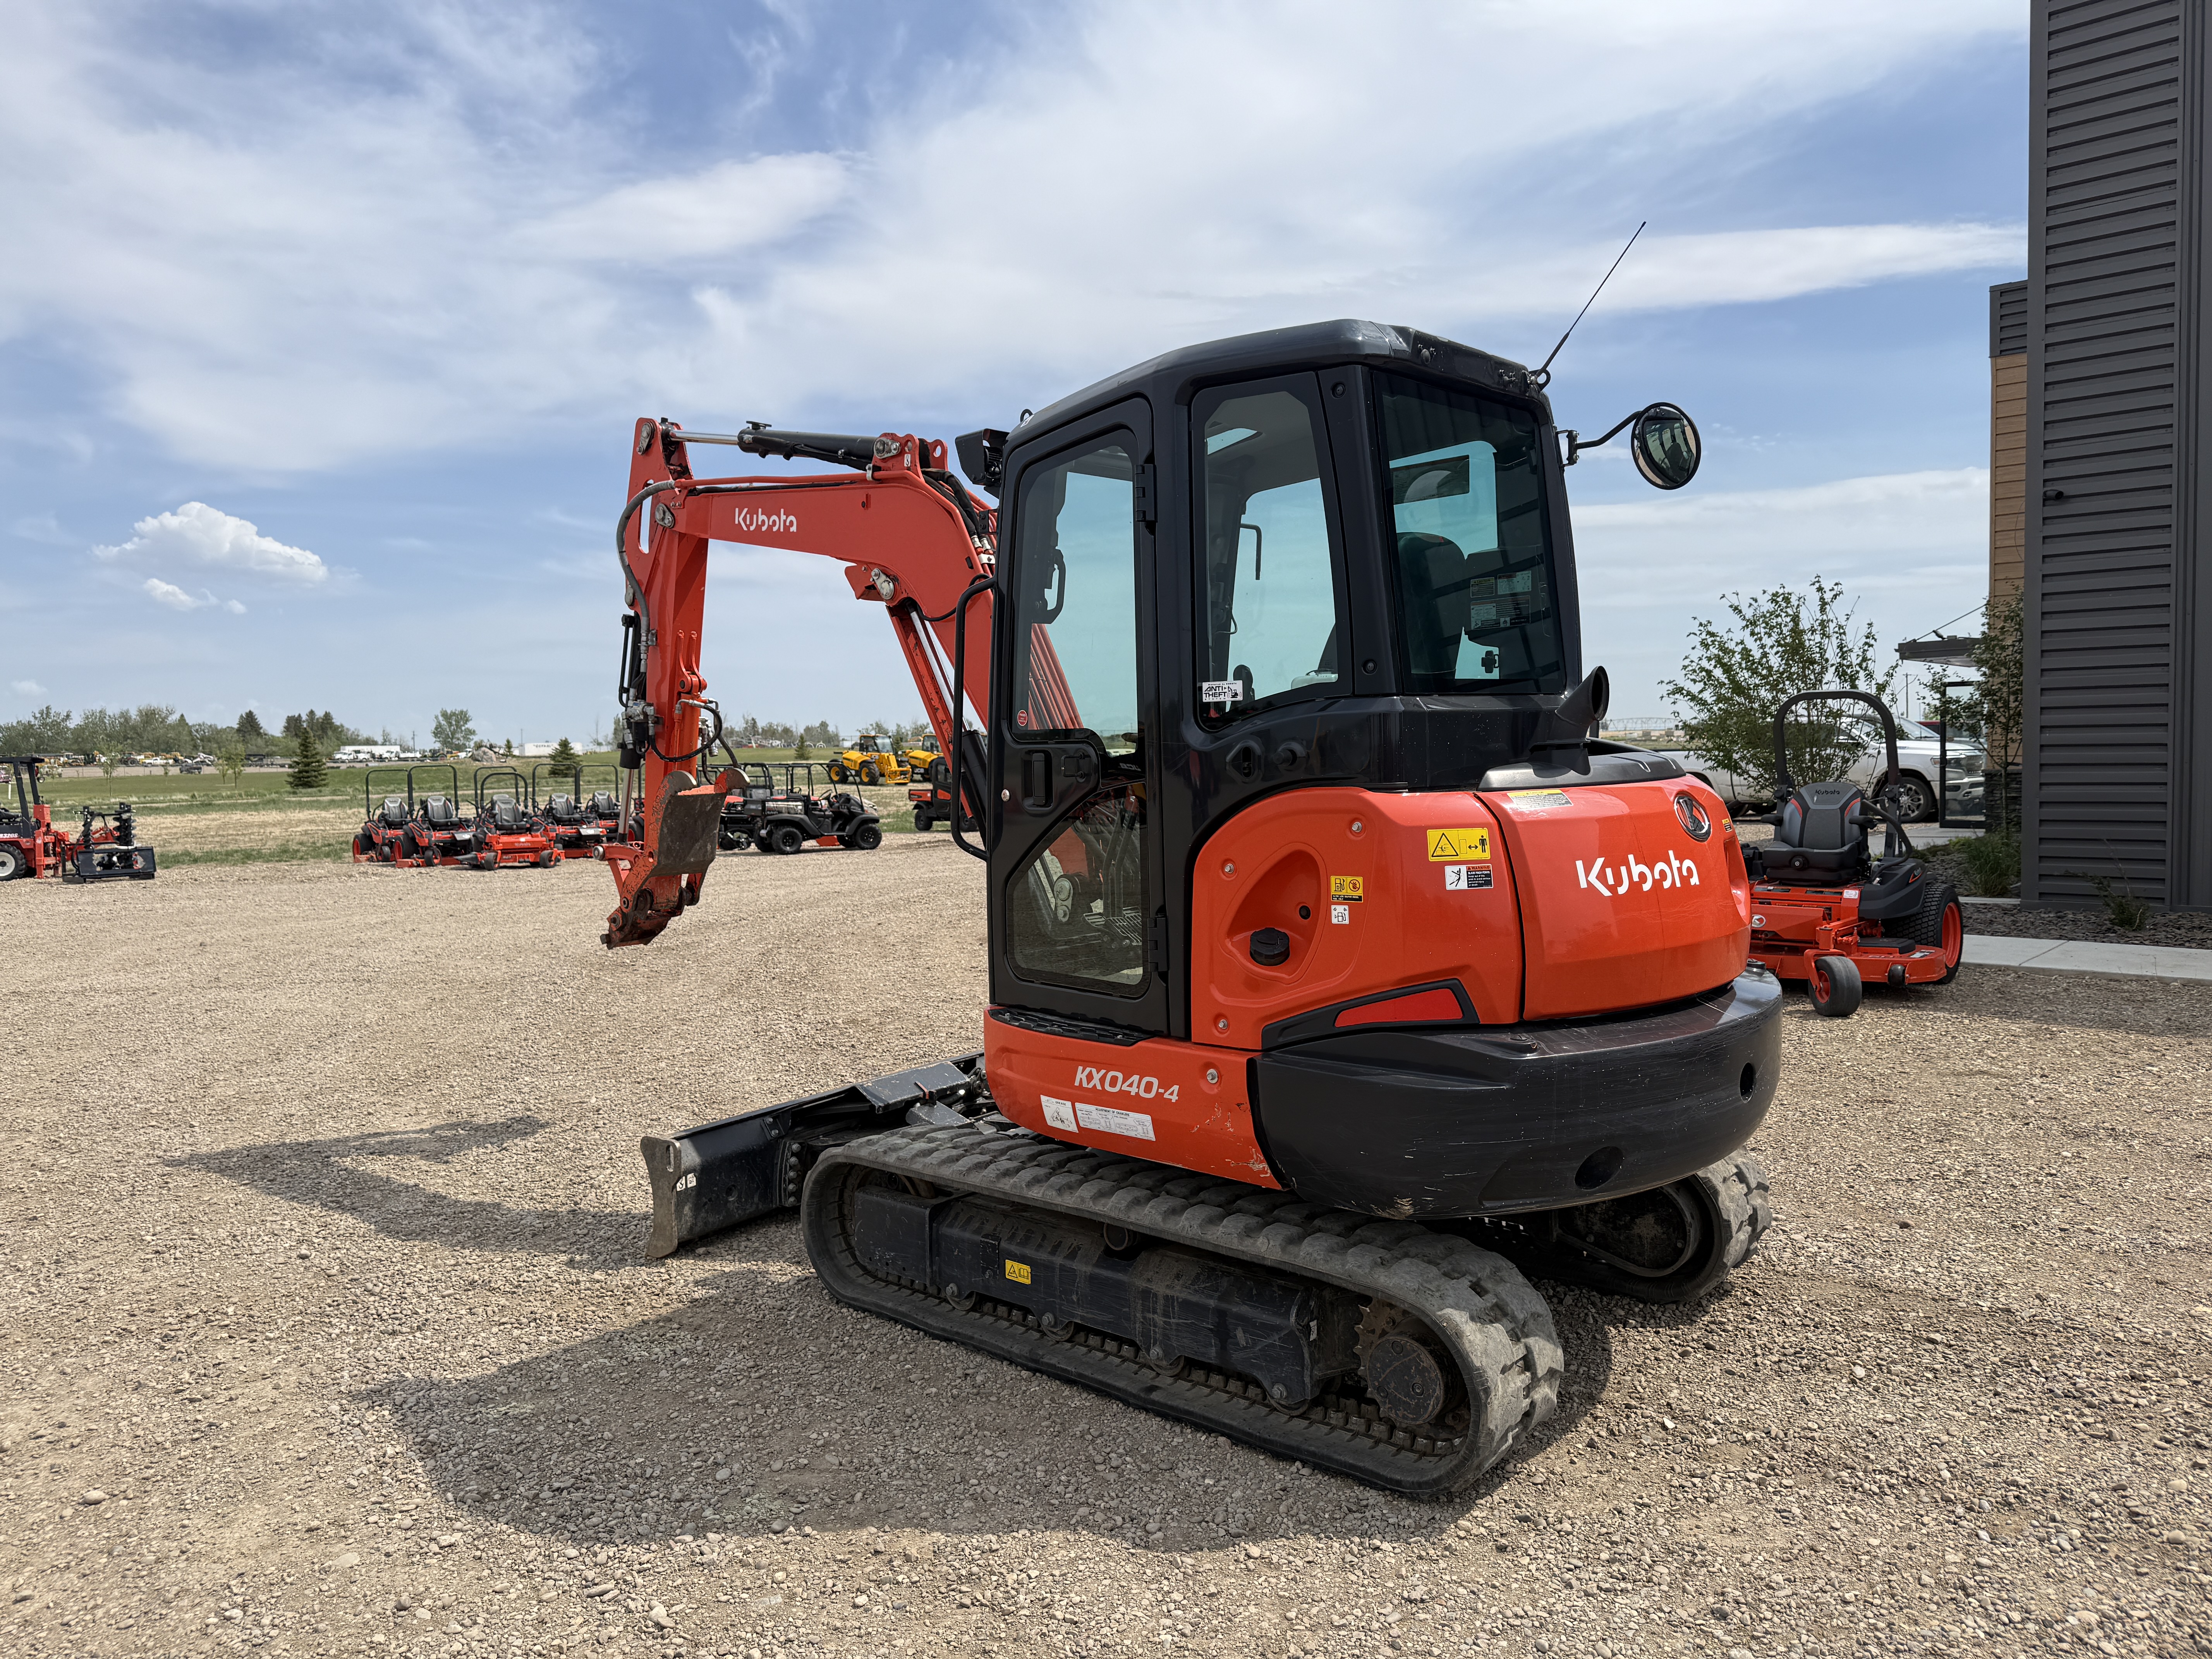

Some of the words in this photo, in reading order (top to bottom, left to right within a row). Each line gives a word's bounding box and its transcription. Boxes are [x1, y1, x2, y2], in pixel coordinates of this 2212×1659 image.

[735, 508, 797, 532] Kubota
[1575, 850, 1700, 896] Kubota
[1074, 1066, 1179, 1103] KX040-4
